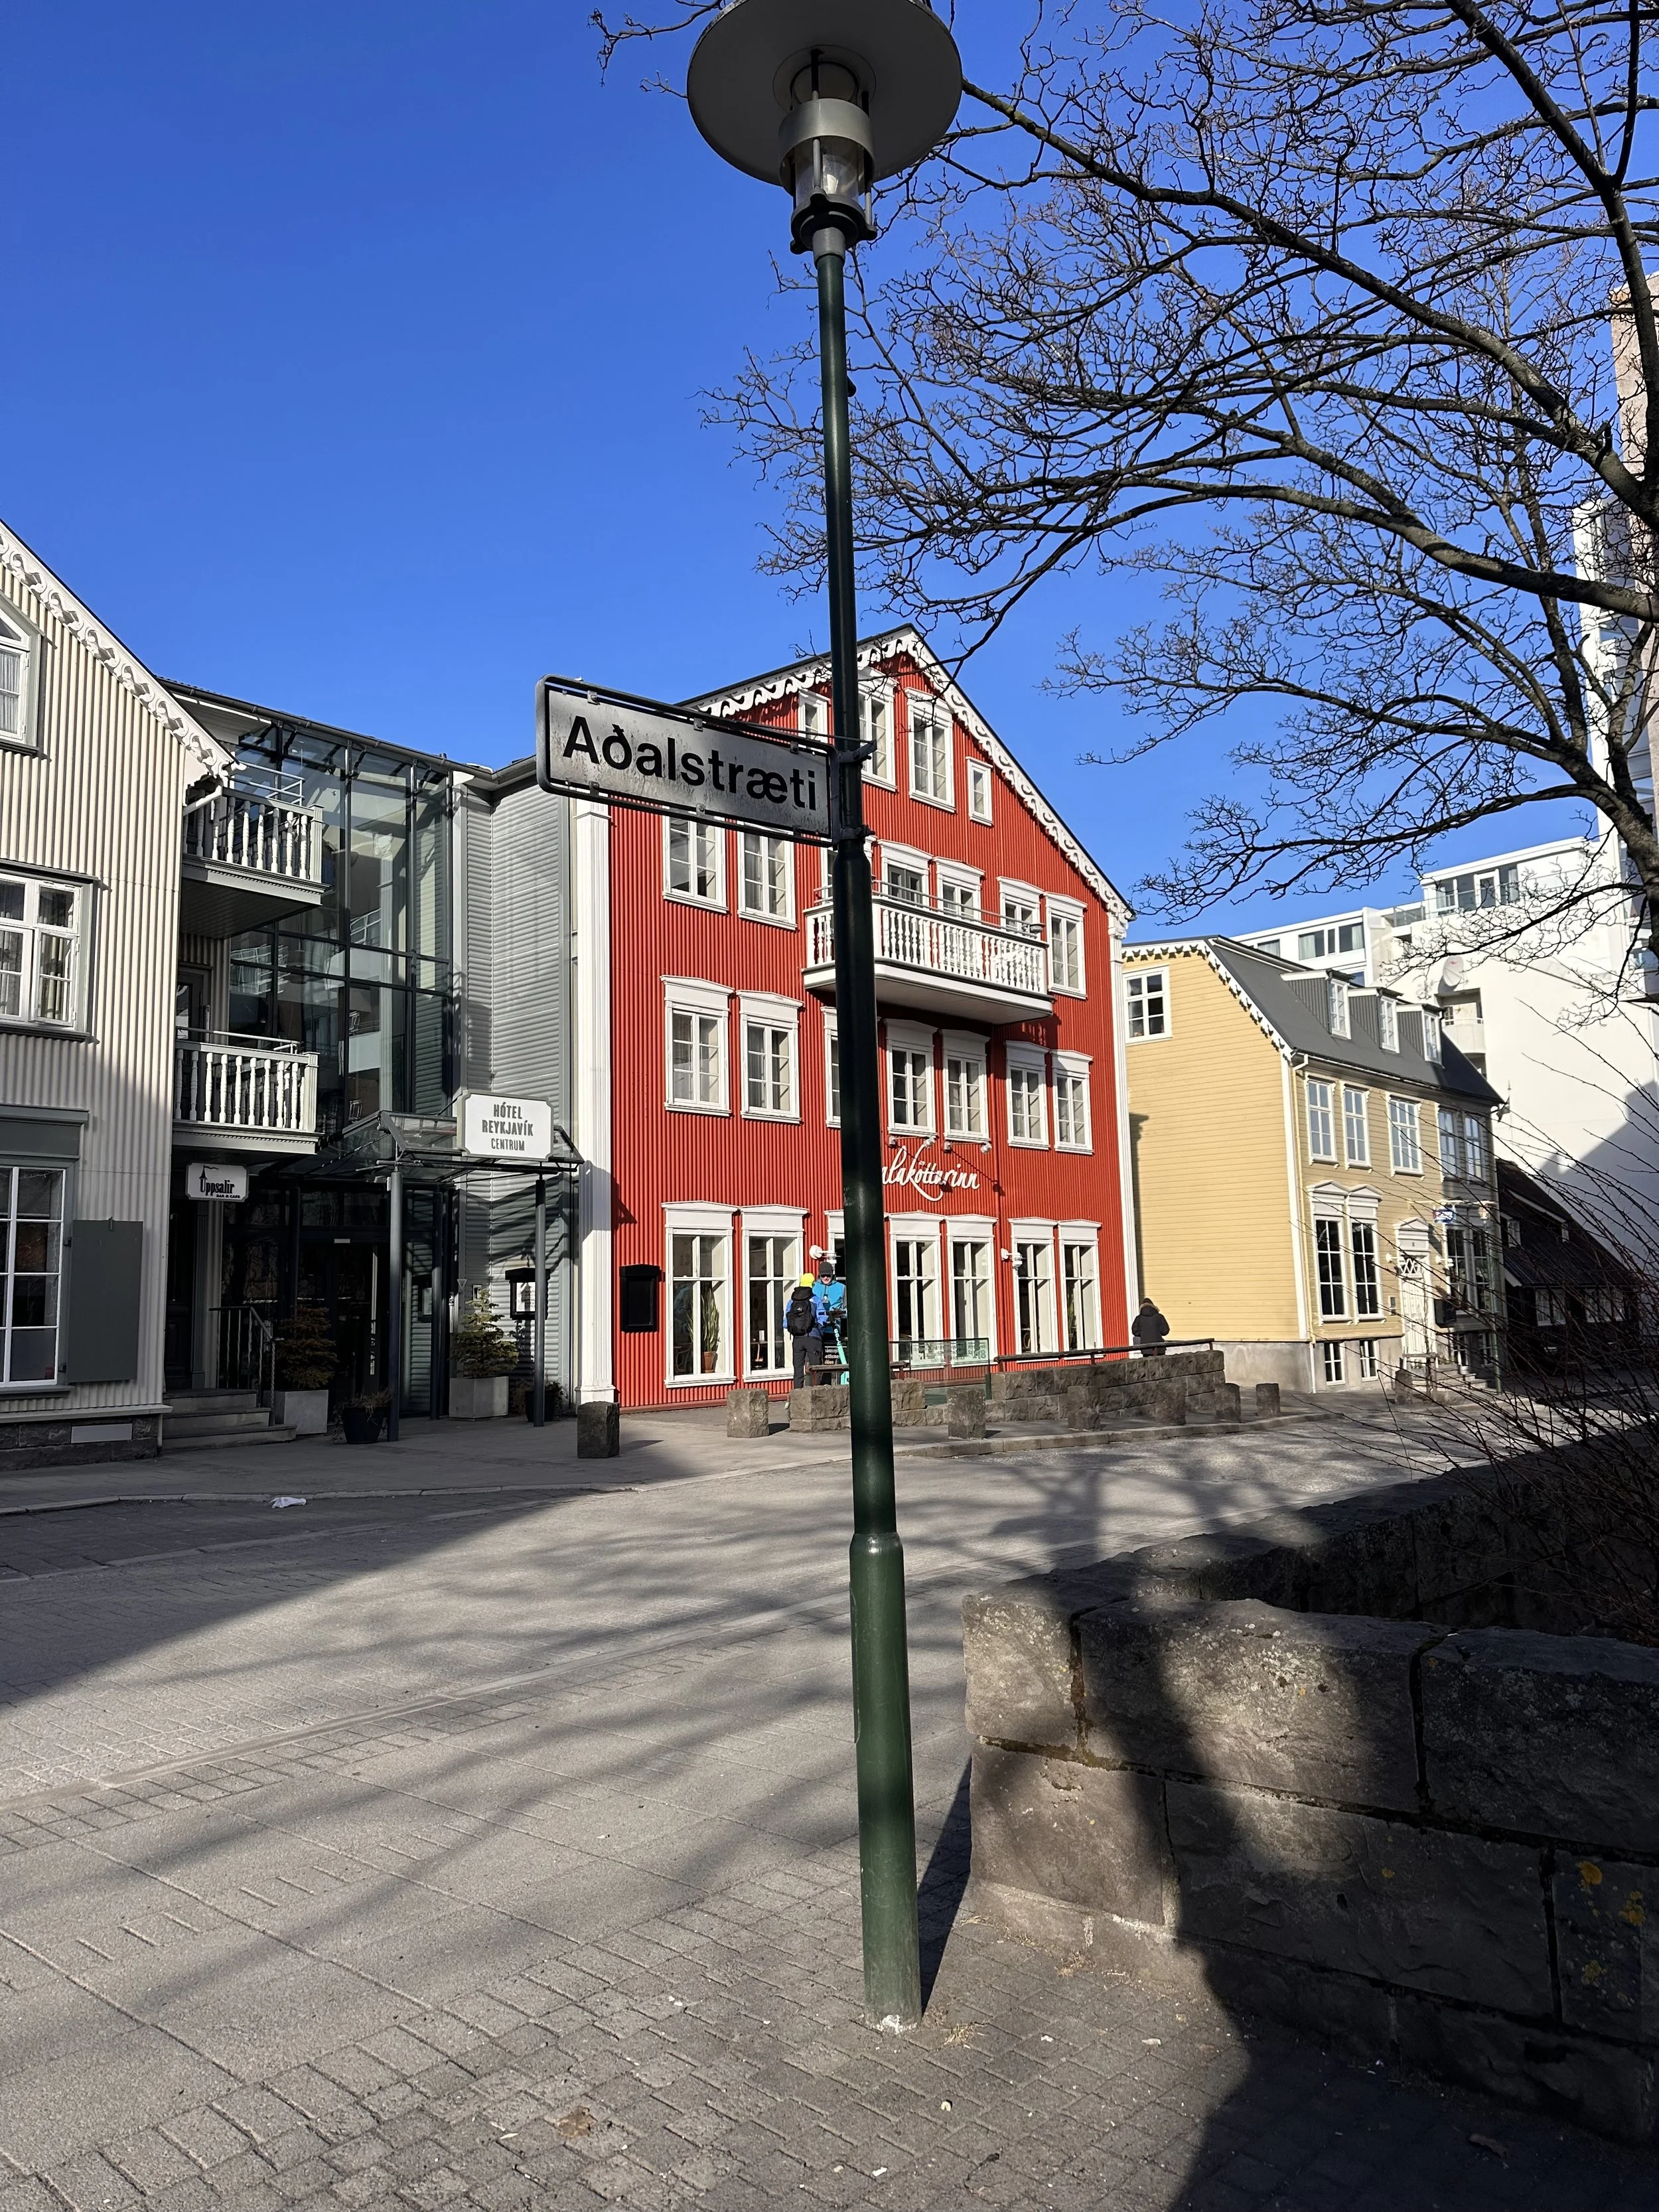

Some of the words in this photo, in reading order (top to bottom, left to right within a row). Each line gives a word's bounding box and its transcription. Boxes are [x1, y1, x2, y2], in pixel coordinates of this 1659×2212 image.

[562, 715, 816, 811] Aðalstræti
[493, 1101, 523, 1120] HÓTEL
[482, 1119, 534, 1136] REYKJAVÍK
[490, 1138, 525, 1151] CENTRUM
[200, 1178, 235, 1196] Uppsalir
